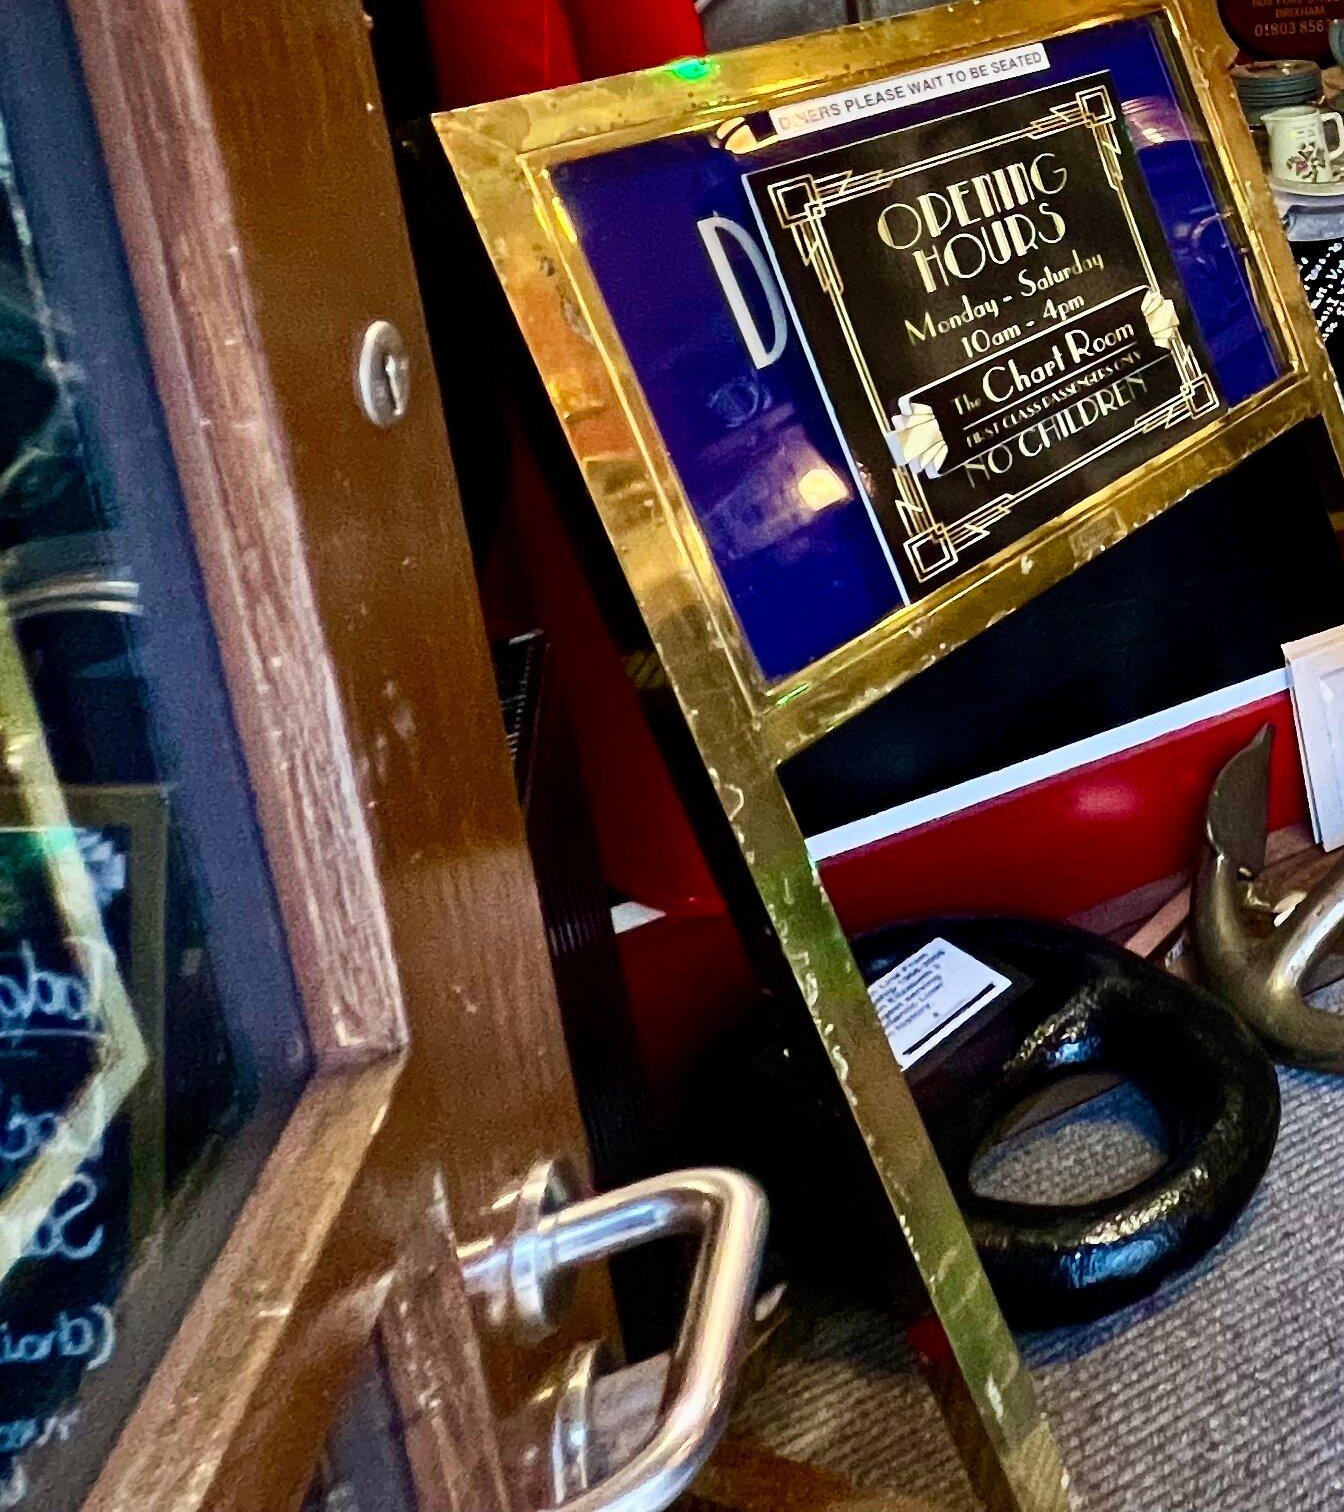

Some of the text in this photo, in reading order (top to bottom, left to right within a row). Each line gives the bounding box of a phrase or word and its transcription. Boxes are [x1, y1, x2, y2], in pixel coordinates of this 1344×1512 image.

[845, 50, 1043, 113] PLEASE WAIT TO BE SEATED
[877, 152, 1068, 250] OPENING
[913, 203, 1066, 294] HOURS
[905, 249, 1106, 347] Monday Saturday
[961, 292, 1086, 359] 10am 4pm
[952, 323, 1135, 416] The Chart Room
[1002, 401, 1043, 429] CLASS
[963, 372, 1148, 488] NO CHILDREN
